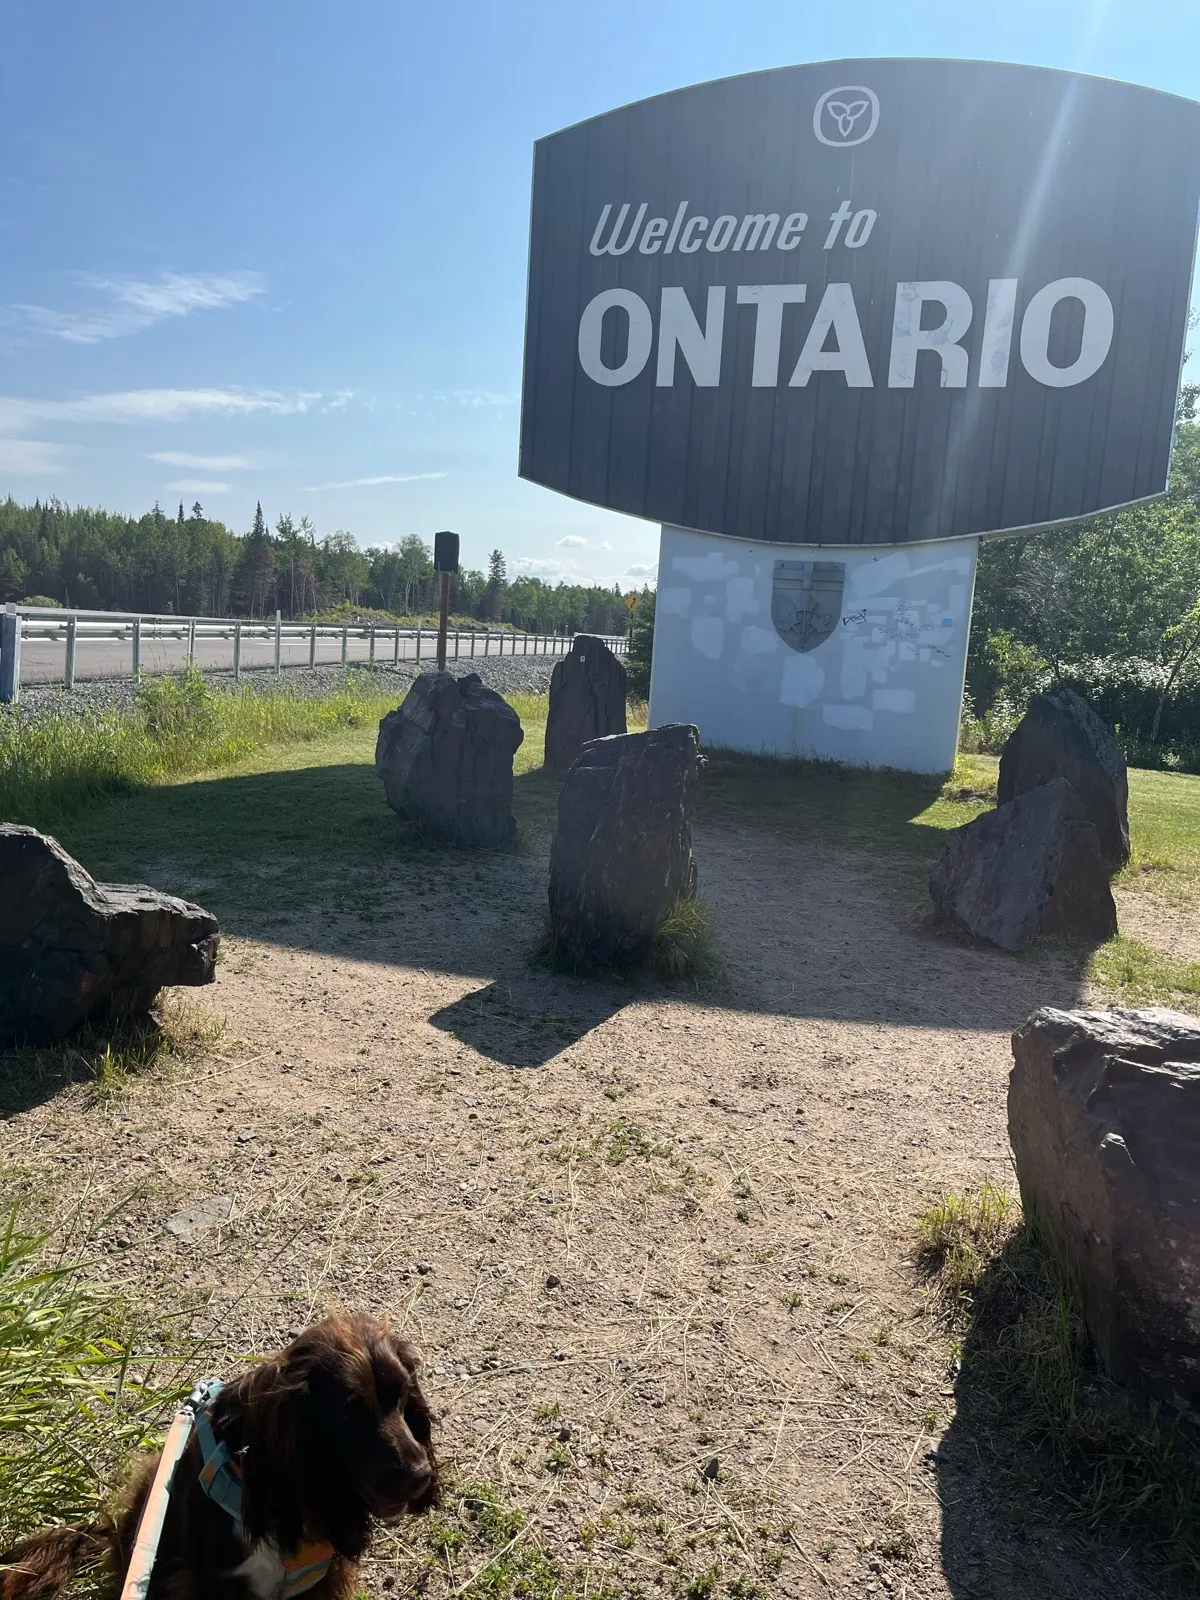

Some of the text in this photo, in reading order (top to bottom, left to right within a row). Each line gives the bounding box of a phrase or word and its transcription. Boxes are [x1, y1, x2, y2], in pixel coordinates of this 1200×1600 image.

[589, 200, 878, 257] Welcome to
[578, 276, 1114, 389] ONTARIO
